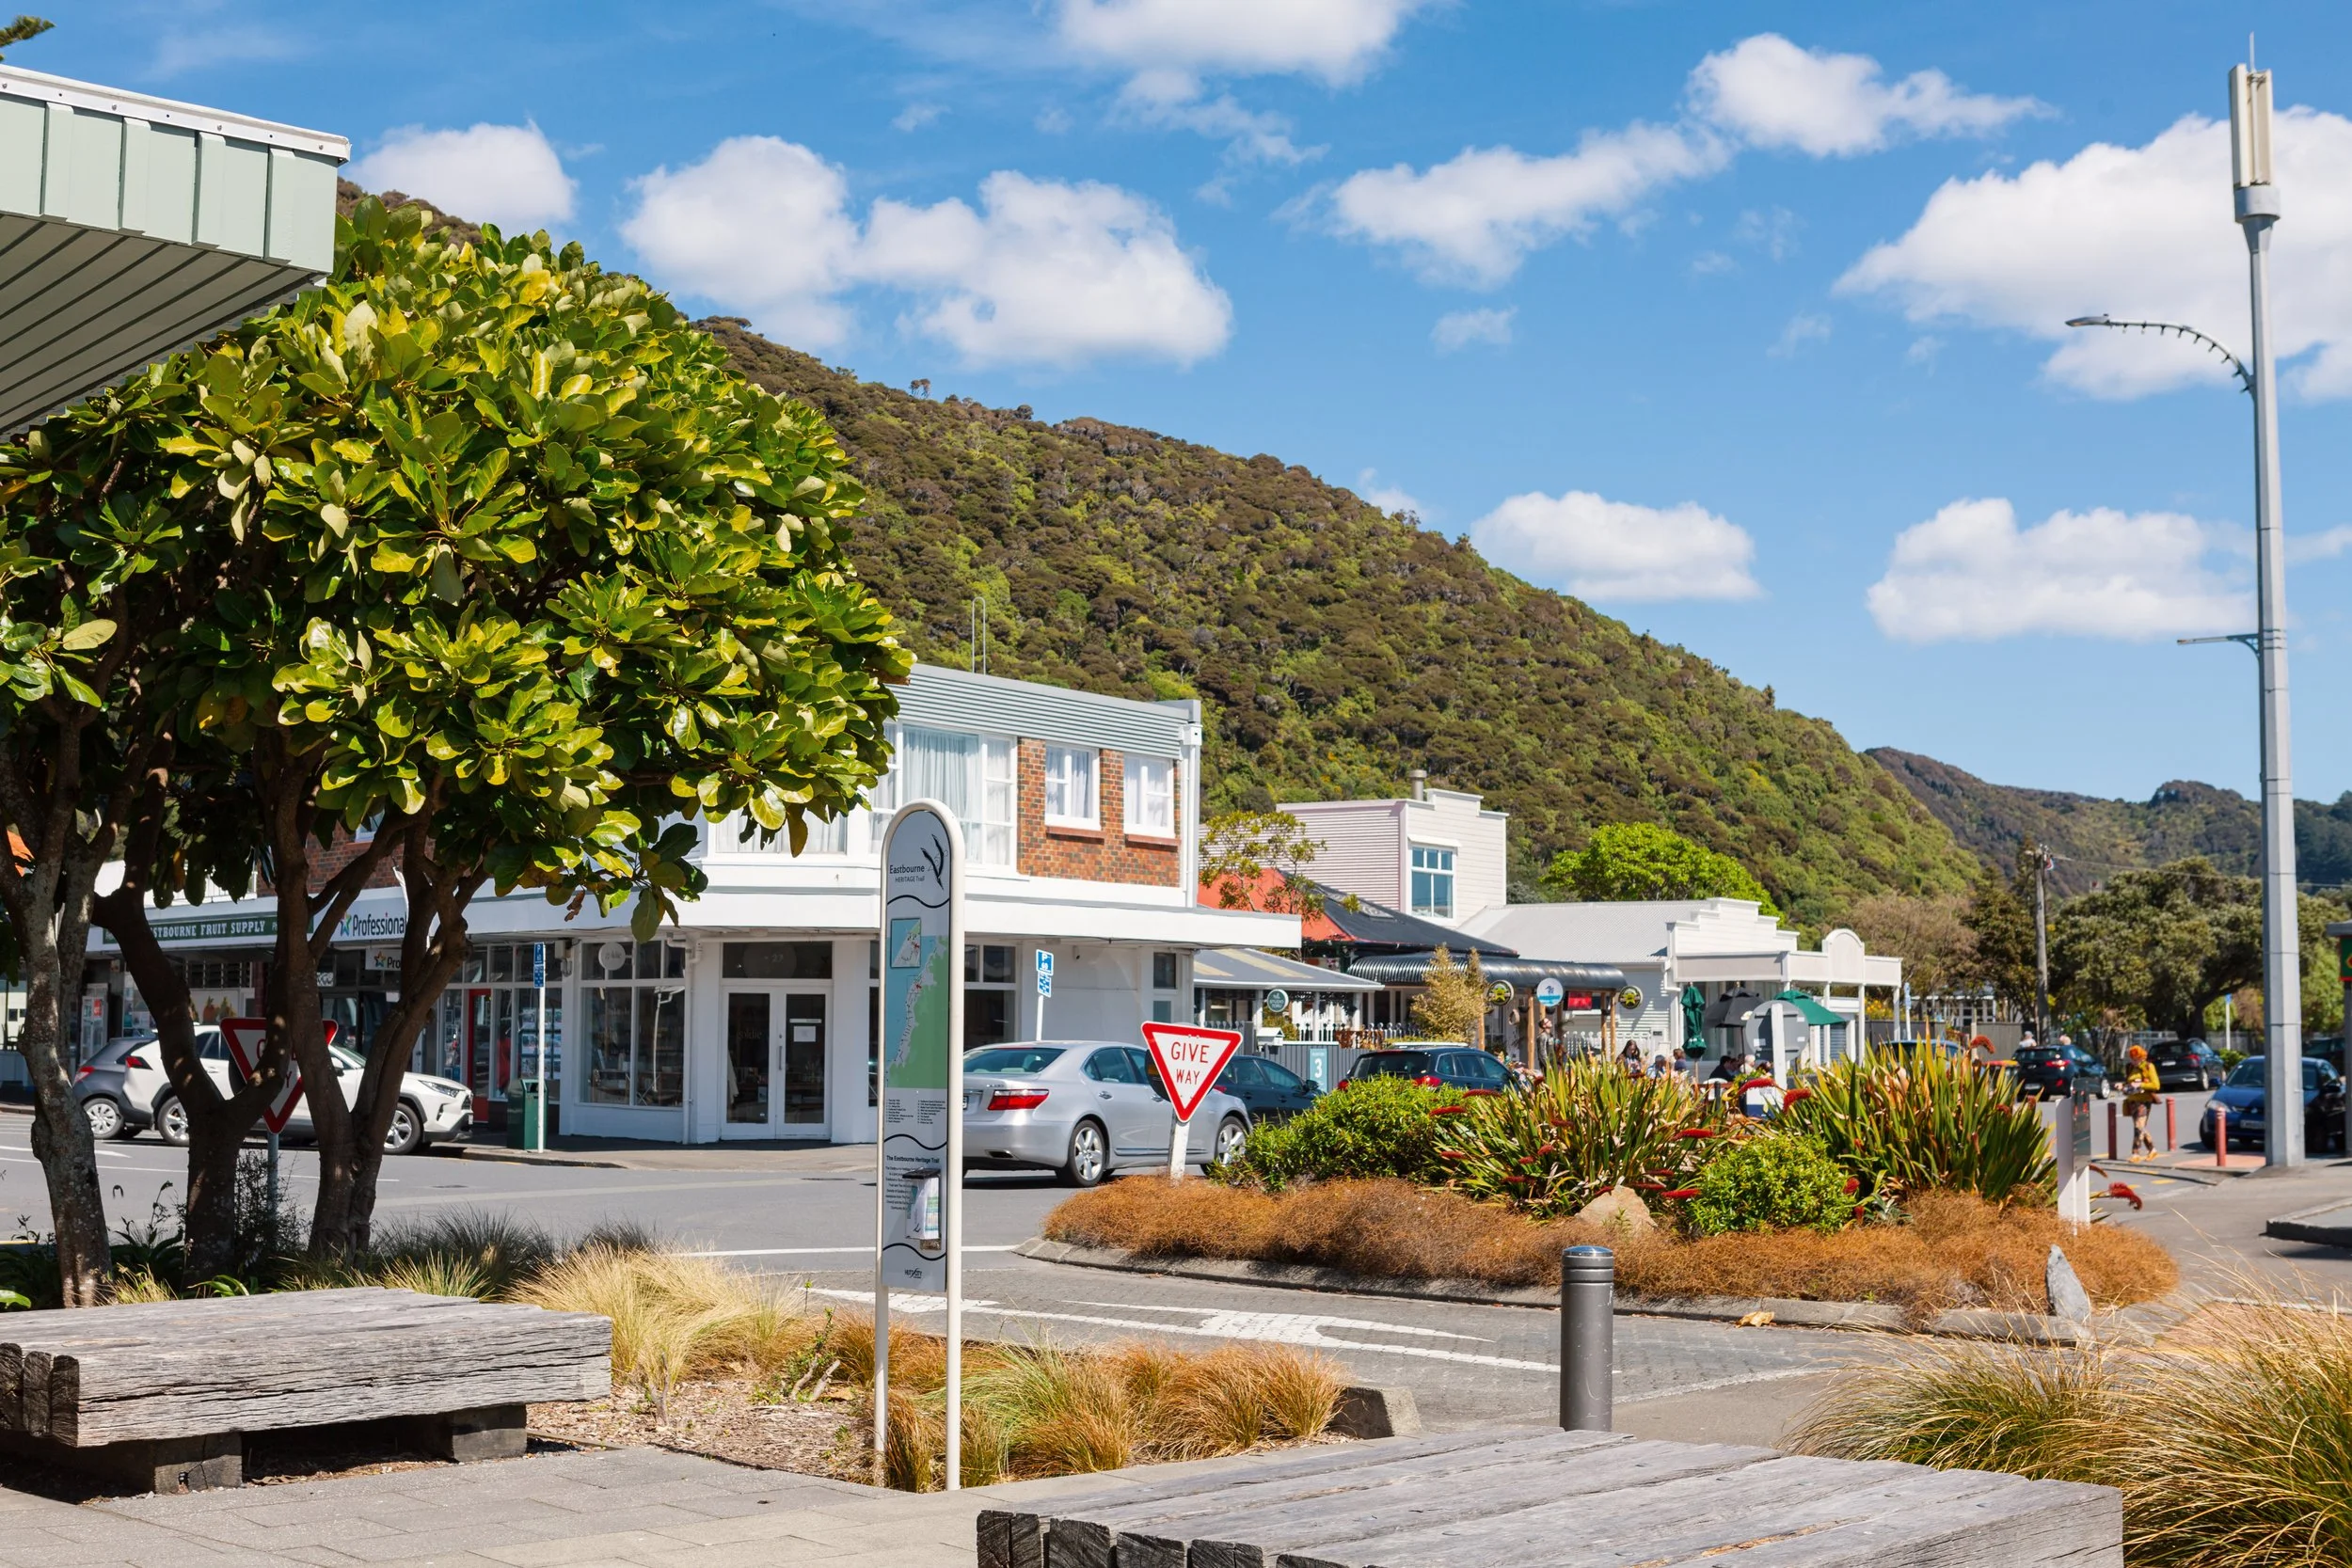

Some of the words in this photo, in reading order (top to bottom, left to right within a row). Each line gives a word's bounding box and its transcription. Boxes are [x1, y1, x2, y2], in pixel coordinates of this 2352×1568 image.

[889, 864, 925, 875] Eastbourne
[151, 924, 197, 939] STBOURNE
[200, 922, 228, 936] FRUIT
[230, 920, 265, 934] SUPPLY
[1170, 1041, 1210, 1063] GIVE
[1176, 1069, 1200, 1085] WAY
[1314, 1058, 1323, 1078] 3
